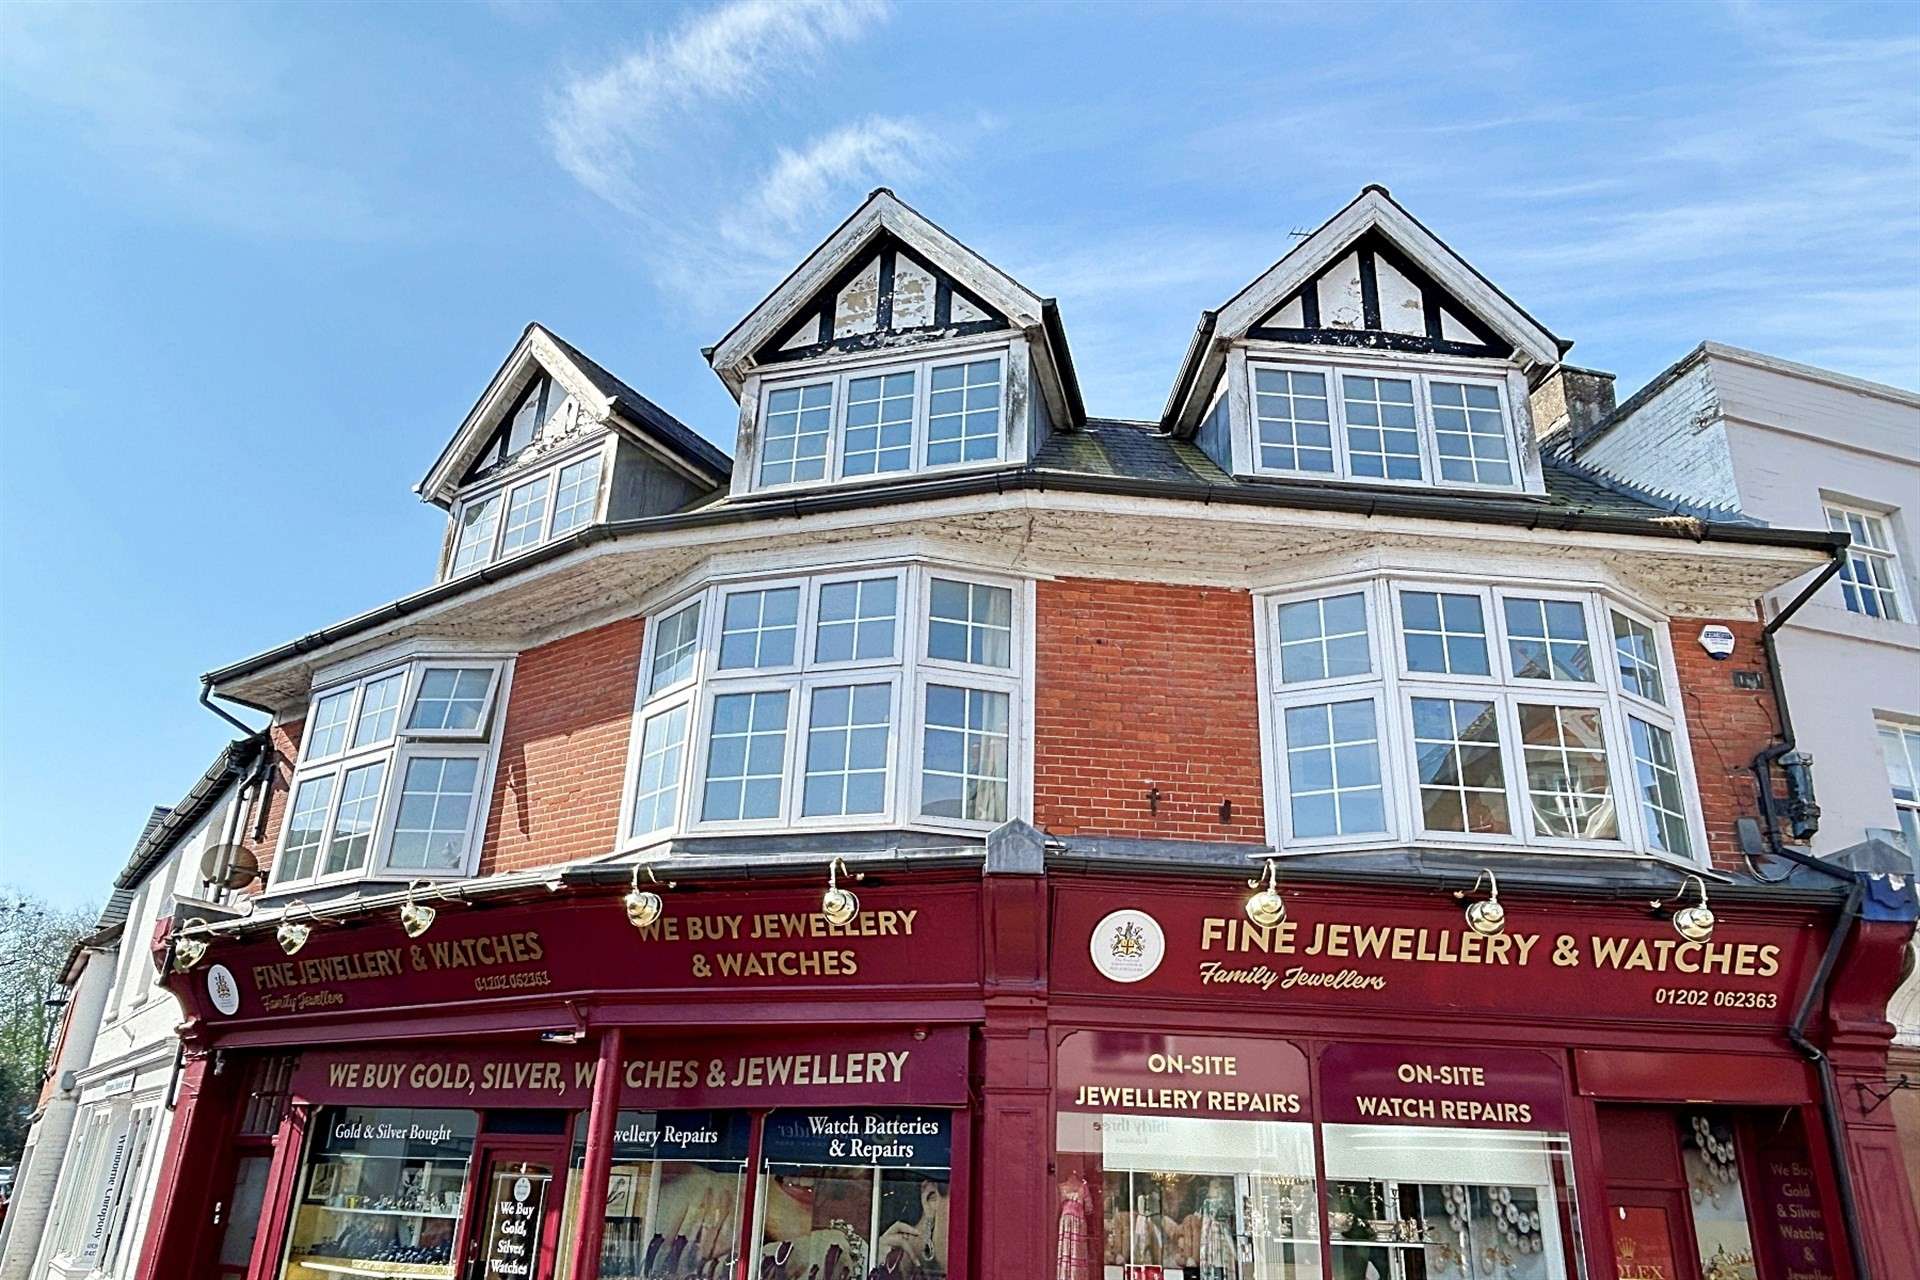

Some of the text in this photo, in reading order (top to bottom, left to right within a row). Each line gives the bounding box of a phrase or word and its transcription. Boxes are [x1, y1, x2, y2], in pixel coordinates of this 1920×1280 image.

[638, 917, 680, 942] WE
[687, 915, 743, 941] BUY
[1201, 918, 1781, 977] FINE JEWELLERY & WATCHES
[252, 931, 543, 990] FINE JEWELLERY & WATCHES
[692, 951, 858, 978] & WATCHES
[1200, 962, 1387, 991] Family Jewellers
[261, 990, 344, 1012] Family Jewellers
[1655, 988, 1778, 1009] 01202 062363
[329, 1051, 910, 1096] WE BUY GOLD, SILVER, WCHES & JEWELLERY
[1148, 1053, 1237, 1076] ON-SITE
[1397, 1064, 1486, 1086] ON-SITE
[1075, 1086, 1301, 1113] JEWELLERY REPAIRS
[1356, 1096, 1532, 1123] WATCH REPAIRS
[335, 1123, 451, 1145] Gold & Silver Bought
[613, 1123, 718, 1148] wellery Repairs
[808, 1115, 859, 1135] Watch
[864, 1116, 939, 1135] Batteries
[829, 1138, 914, 1160] & Repairs
[1770, 1162, 1790, 1177] We
[1782, 1183, 1811, 1197] Gold
[500, 1201, 535, 1220] We Buy
[1776, 1203, 1787, 1218] &
[501, 1220, 527, 1237] Gold,
[1779, 1224, 1825, 1240] Watche
[497, 1240, 526, 1257] Silver,
[1803, 1246, 1816, 1262] &
[491, 1259, 528, 1275] Watches
